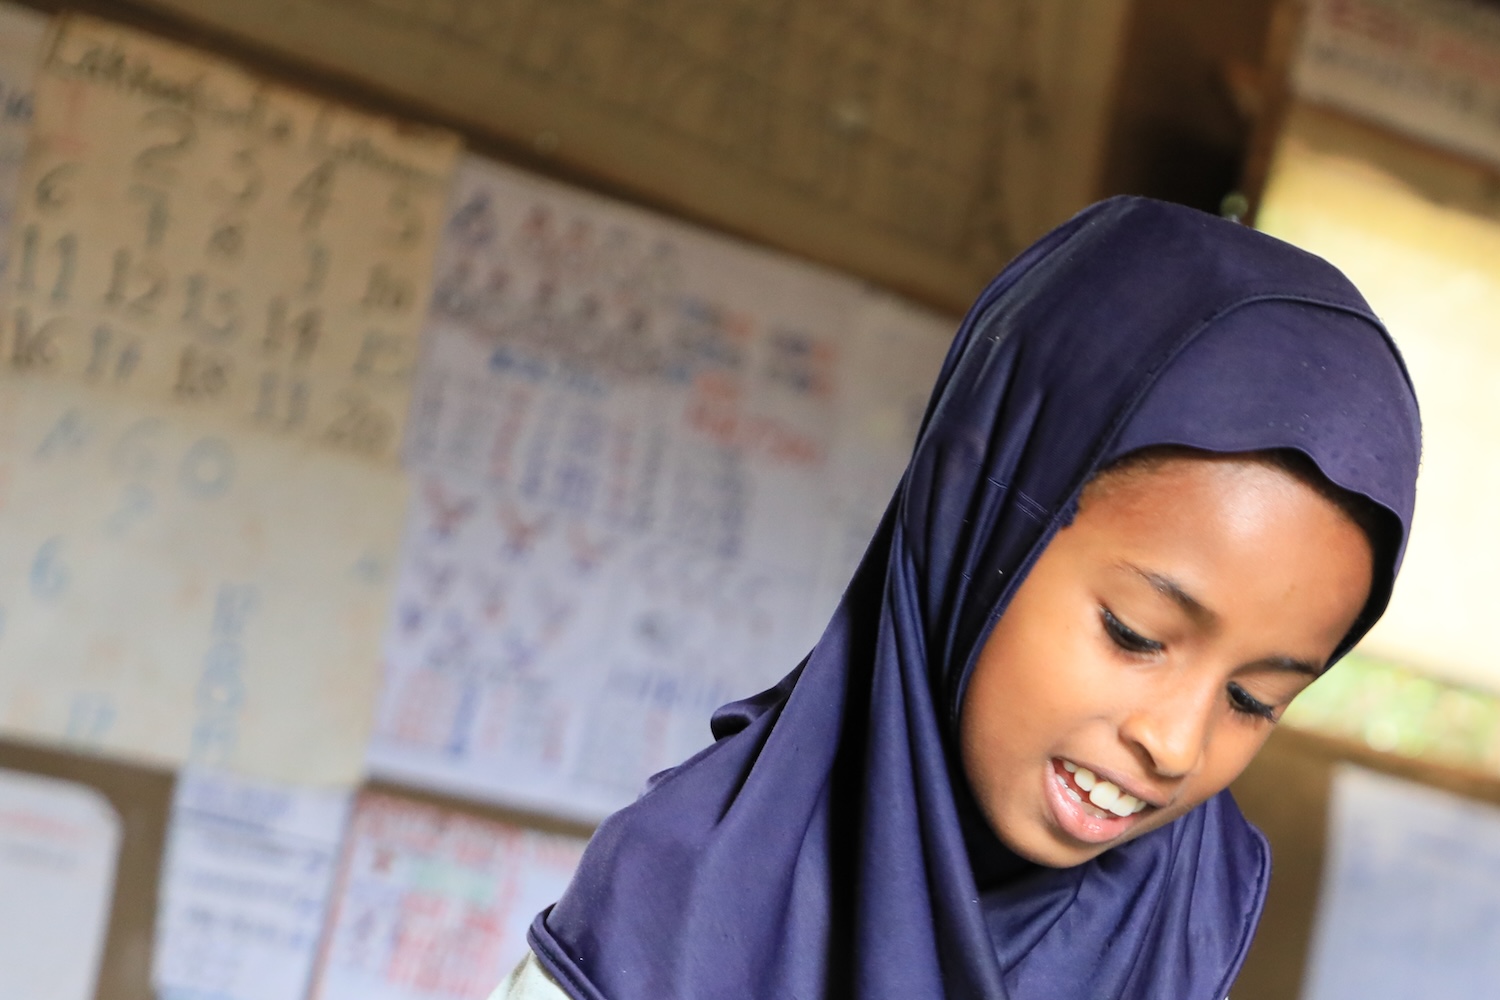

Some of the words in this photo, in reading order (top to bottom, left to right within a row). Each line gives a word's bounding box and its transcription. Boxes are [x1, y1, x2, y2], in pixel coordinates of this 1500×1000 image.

[134, 106, 196, 185] 2
[288, 158, 339, 234] 4
[18, 223, 78, 306] 11
[102, 246, 168, 318] 12
